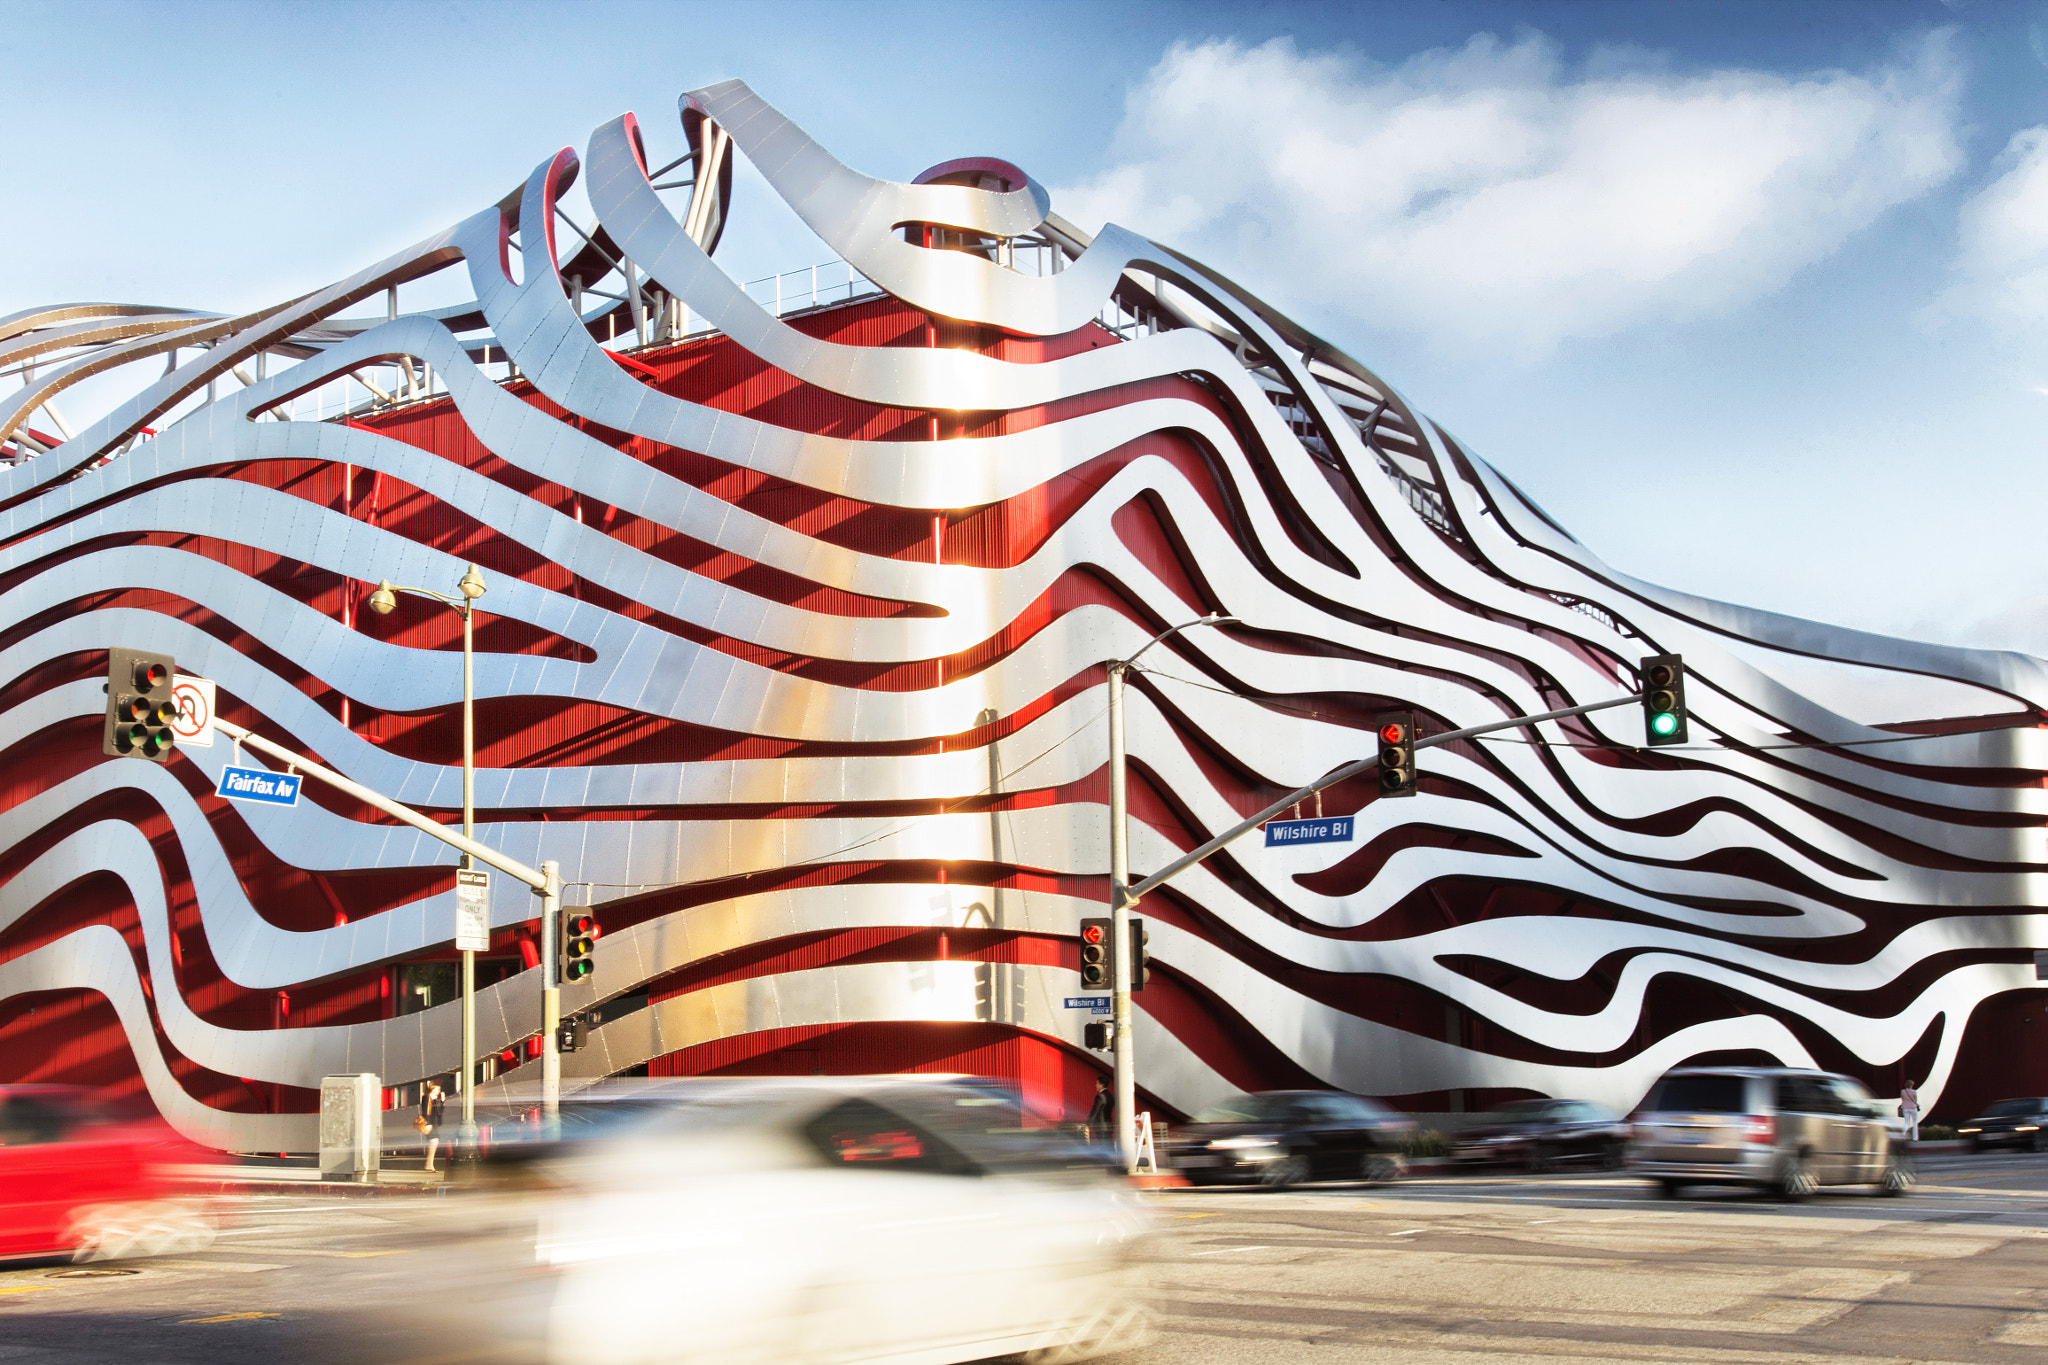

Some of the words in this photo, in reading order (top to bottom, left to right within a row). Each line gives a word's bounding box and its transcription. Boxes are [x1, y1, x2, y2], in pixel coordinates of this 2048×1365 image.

[226, 773, 275, 795] Fairfax
[274, 780, 294, 797] Av
[1273, 825, 1327, 840] Wilshire
[1332, 822, 1347, 836] Bl
[1067, 999, 1095, 1007] Wilshire
